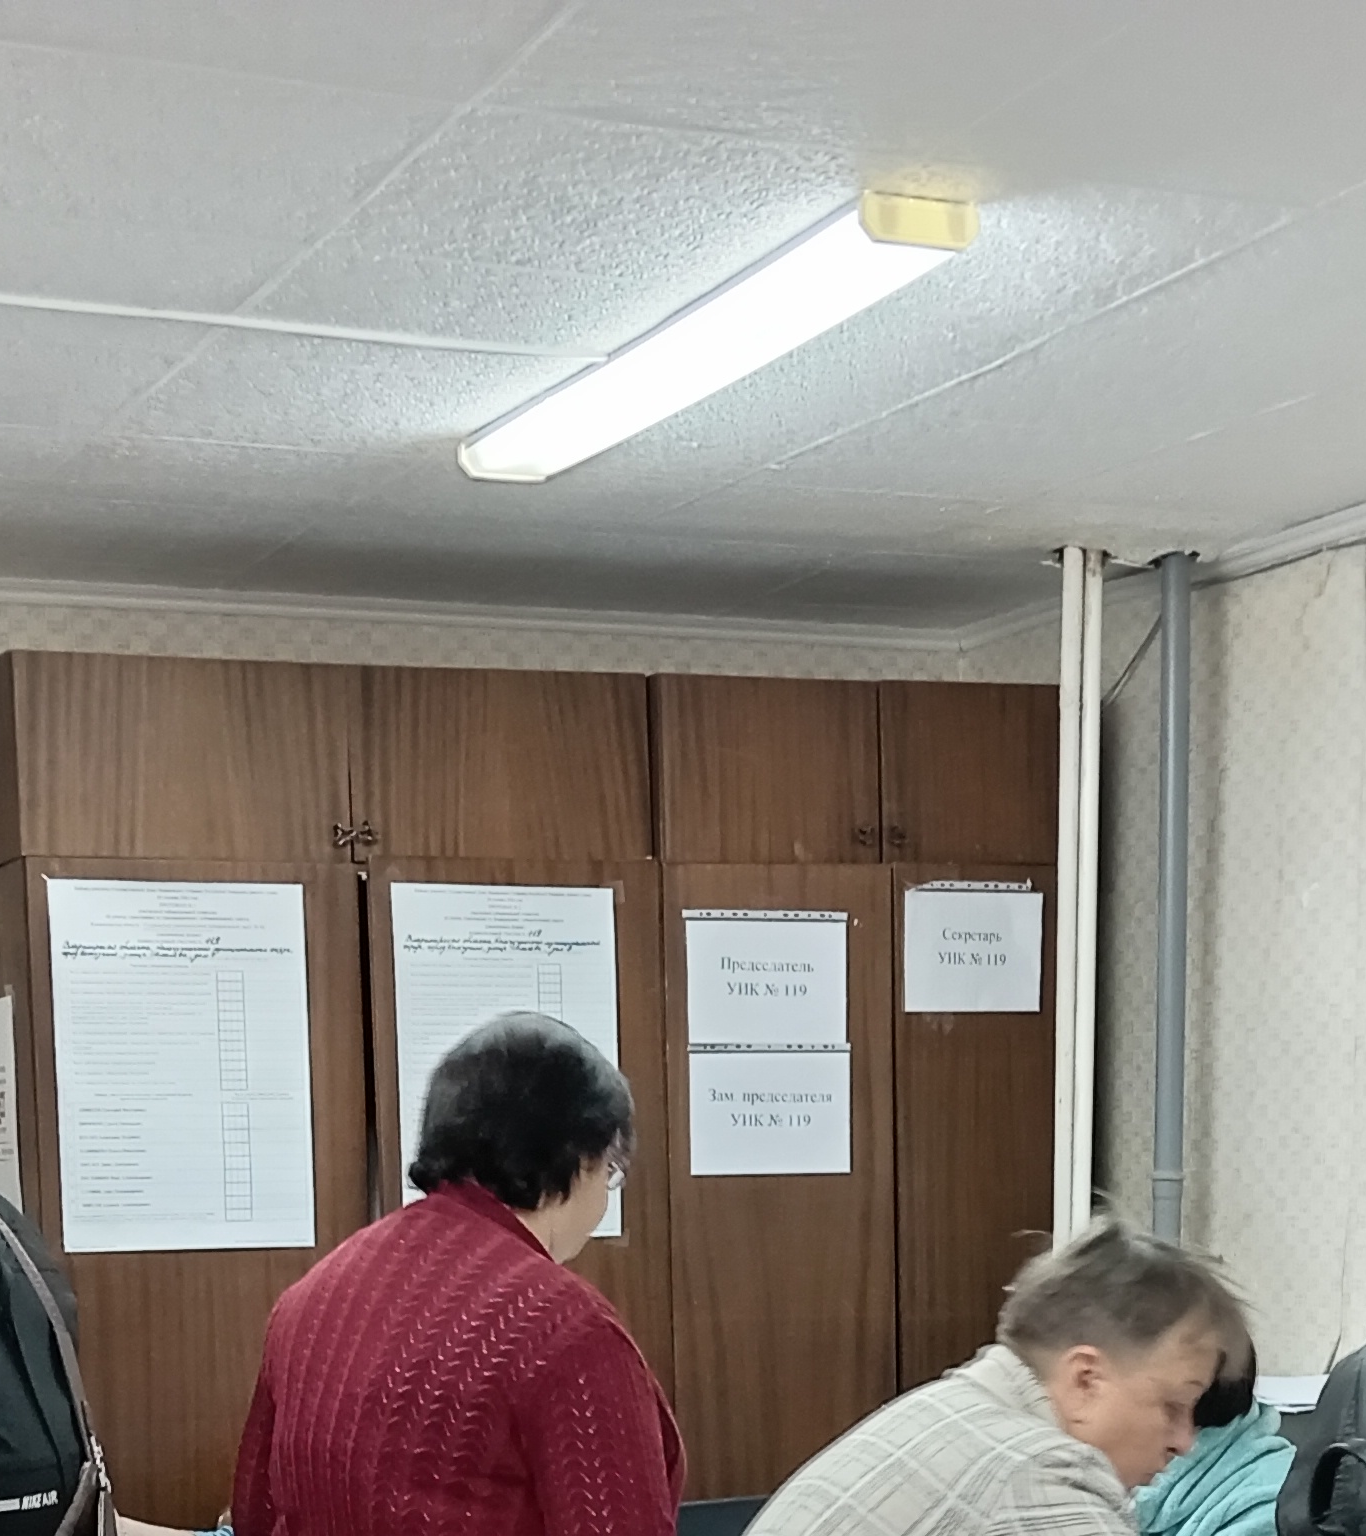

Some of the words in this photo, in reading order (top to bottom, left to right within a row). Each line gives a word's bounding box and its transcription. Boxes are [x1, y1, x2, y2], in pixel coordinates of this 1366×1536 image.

[941, 927, 1003, 944] Секретарь
[720, 956, 815, 974] Председатель
[937, 951, 966, 967] УИК
[969, 953, 984, 967] №
[986, 953, 1007, 967] 119
[726, 981, 760, 997] УИК
[763, 983, 779, 997] №
[785, 983, 808, 997] 119
[742, 1091, 833, 1106] председателя
[730, 1113, 764, 1127] УИК
[767, 1113, 783, 1128] №
[788, 1114, 812, 1127] 119
[21, 1493, 43, 1510] NIKE
[42, 1490, 59, 1506] AIR
